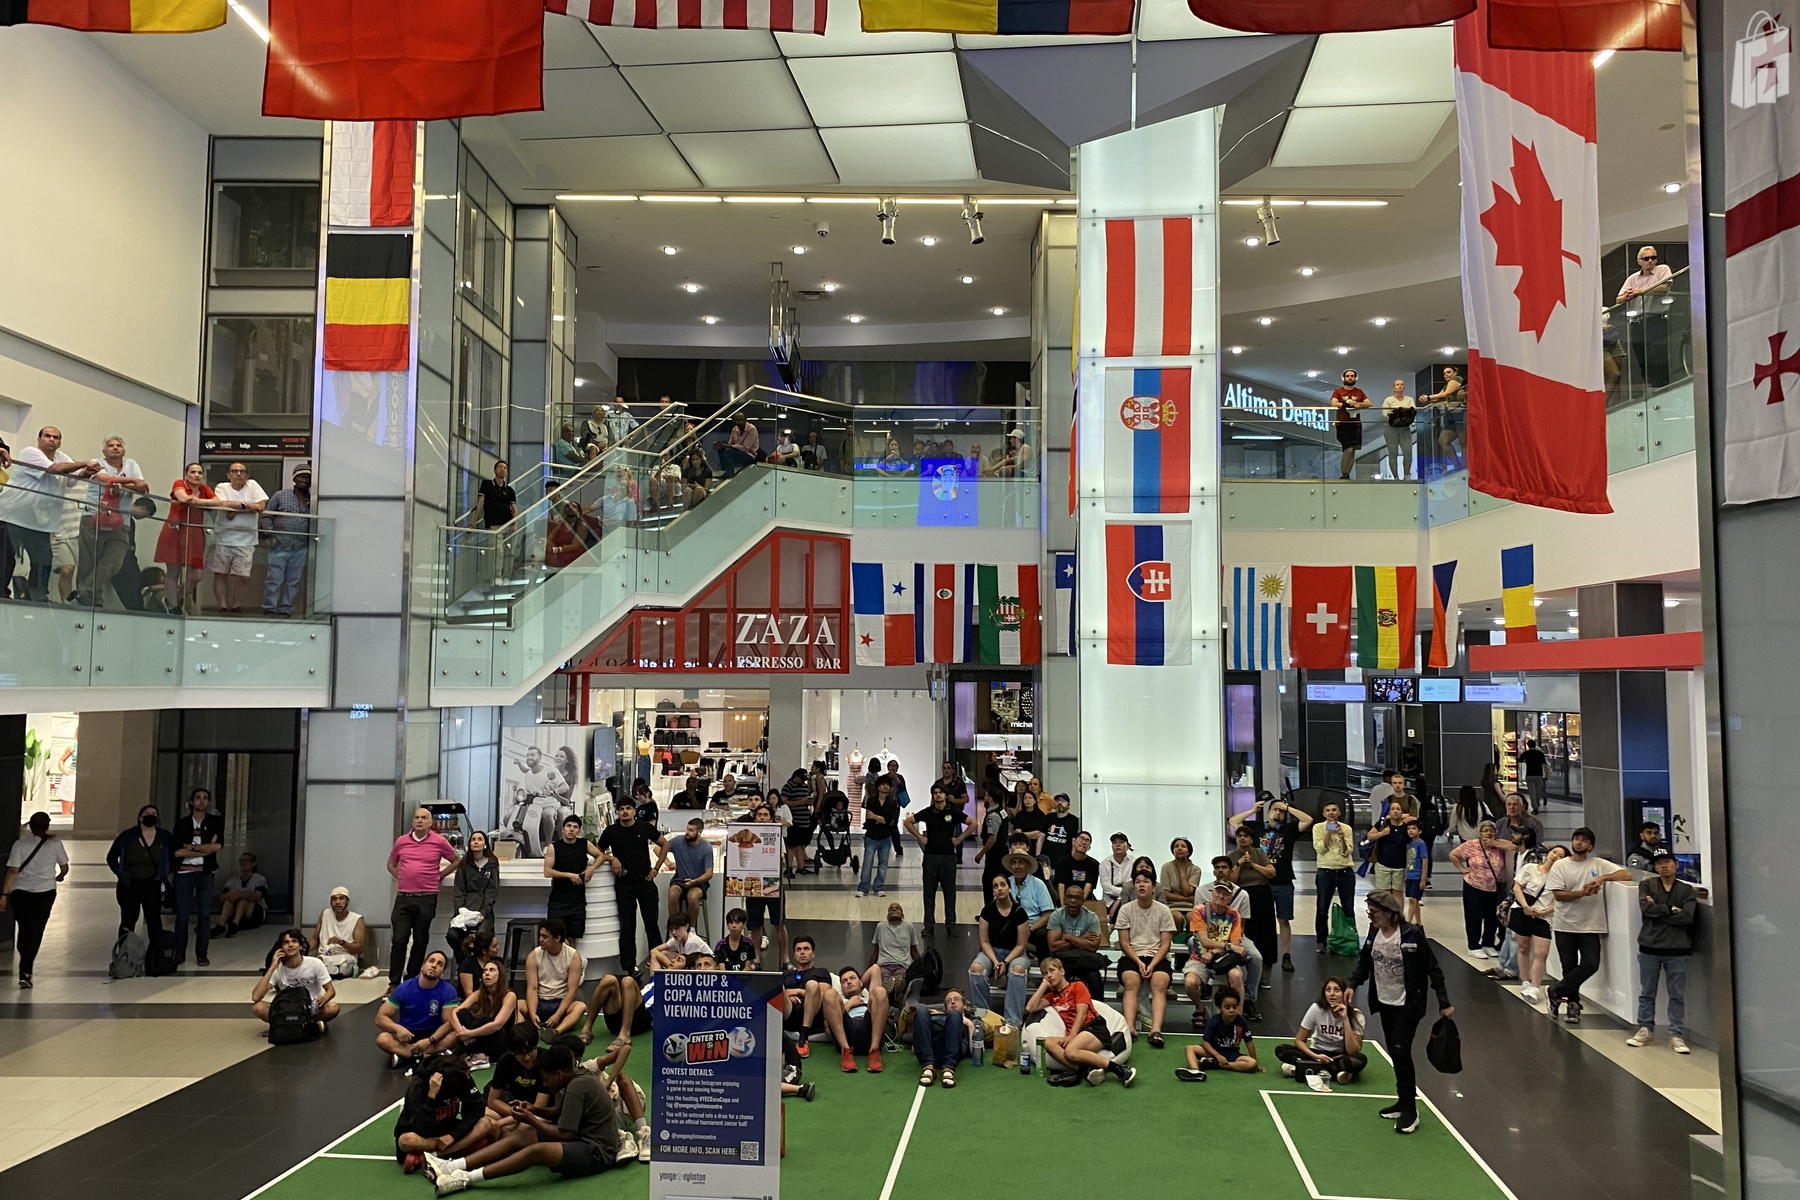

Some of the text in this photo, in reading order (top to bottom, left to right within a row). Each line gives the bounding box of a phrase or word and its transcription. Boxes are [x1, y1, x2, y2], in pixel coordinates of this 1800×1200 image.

[1224, 383, 1329, 432] Altima Dental
[735, 613, 836, 646] ZAZA
[736, 656, 803, 669] ESPRESSO
[815, 657, 841, 669] BAR
[665, 974, 728, 987] EURO CUP &
[664, 989, 743, 1003] COPA AMERICA
[664, 1005, 752, 1019] VIEWING LOUNGE
[692, 1034, 713, 1043] ENTER
